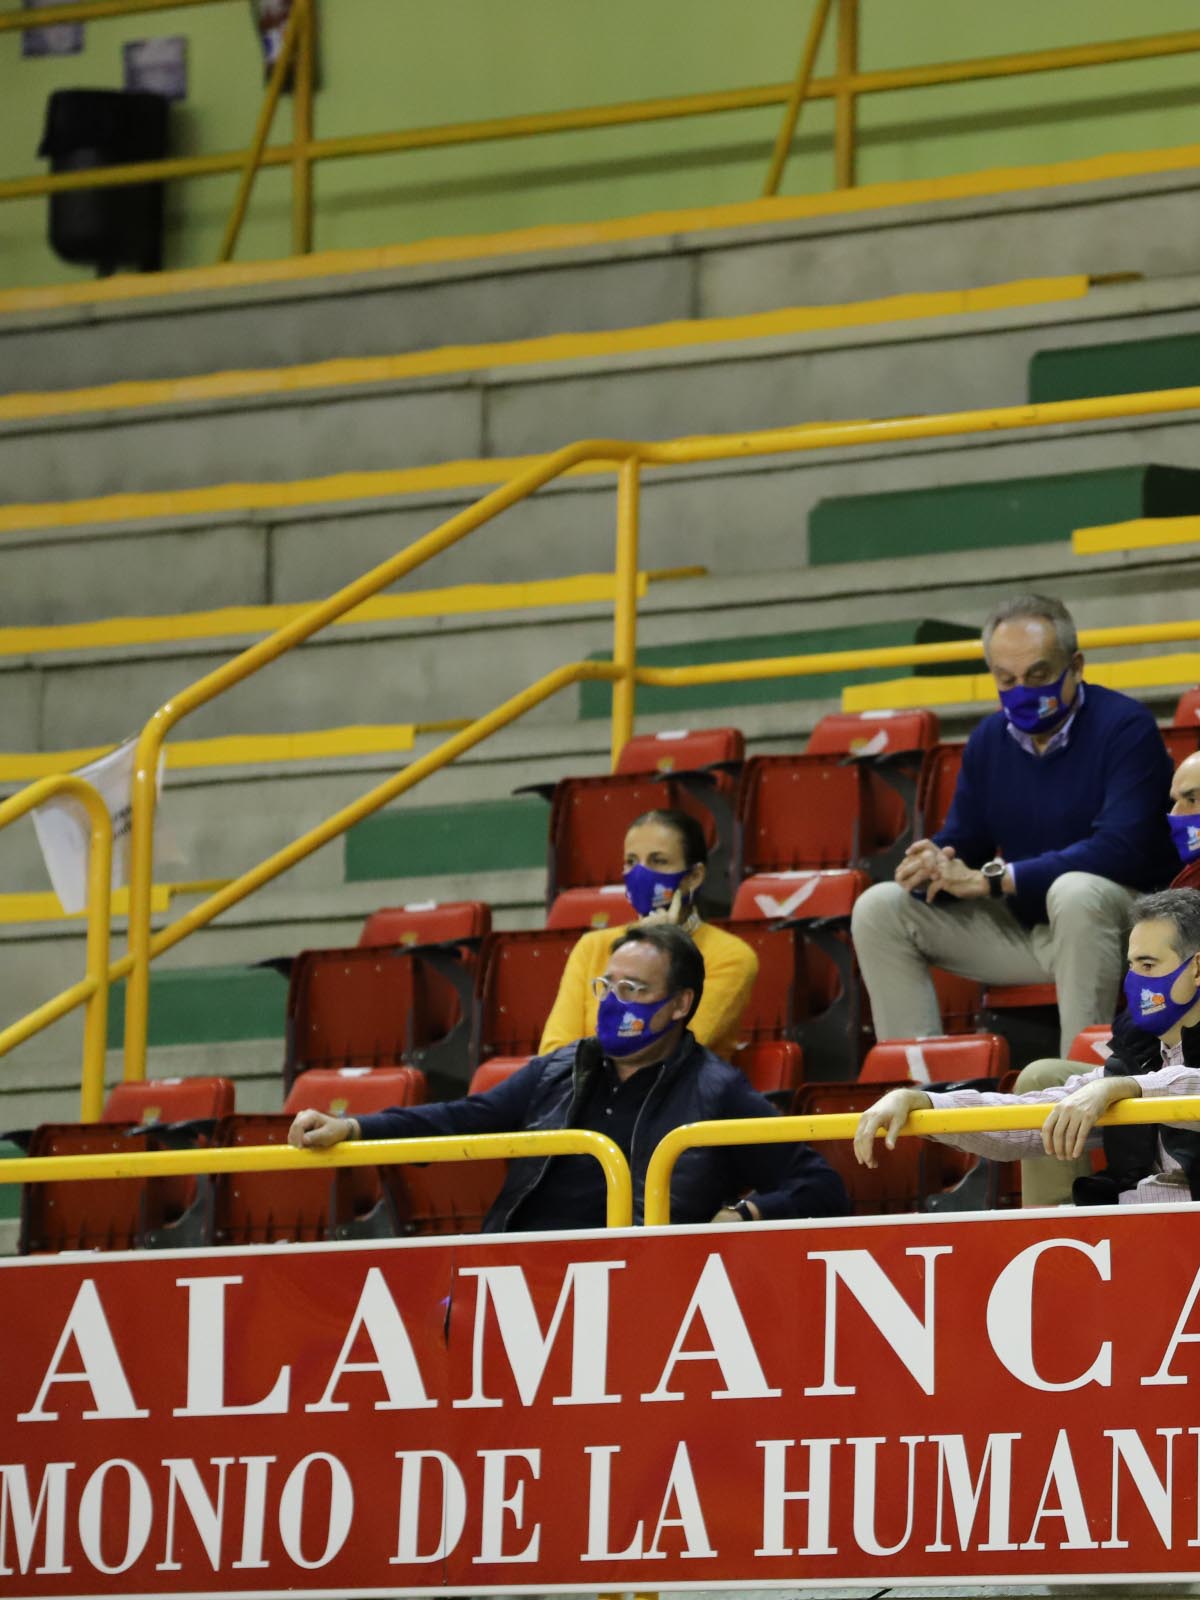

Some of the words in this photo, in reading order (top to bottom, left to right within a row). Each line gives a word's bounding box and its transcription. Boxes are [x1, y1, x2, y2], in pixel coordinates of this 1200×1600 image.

[0, 1448, 354, 1576] MONIO
[389, 1447, 541, 1565] DE
[580, 1440, 718, 1562] LA
